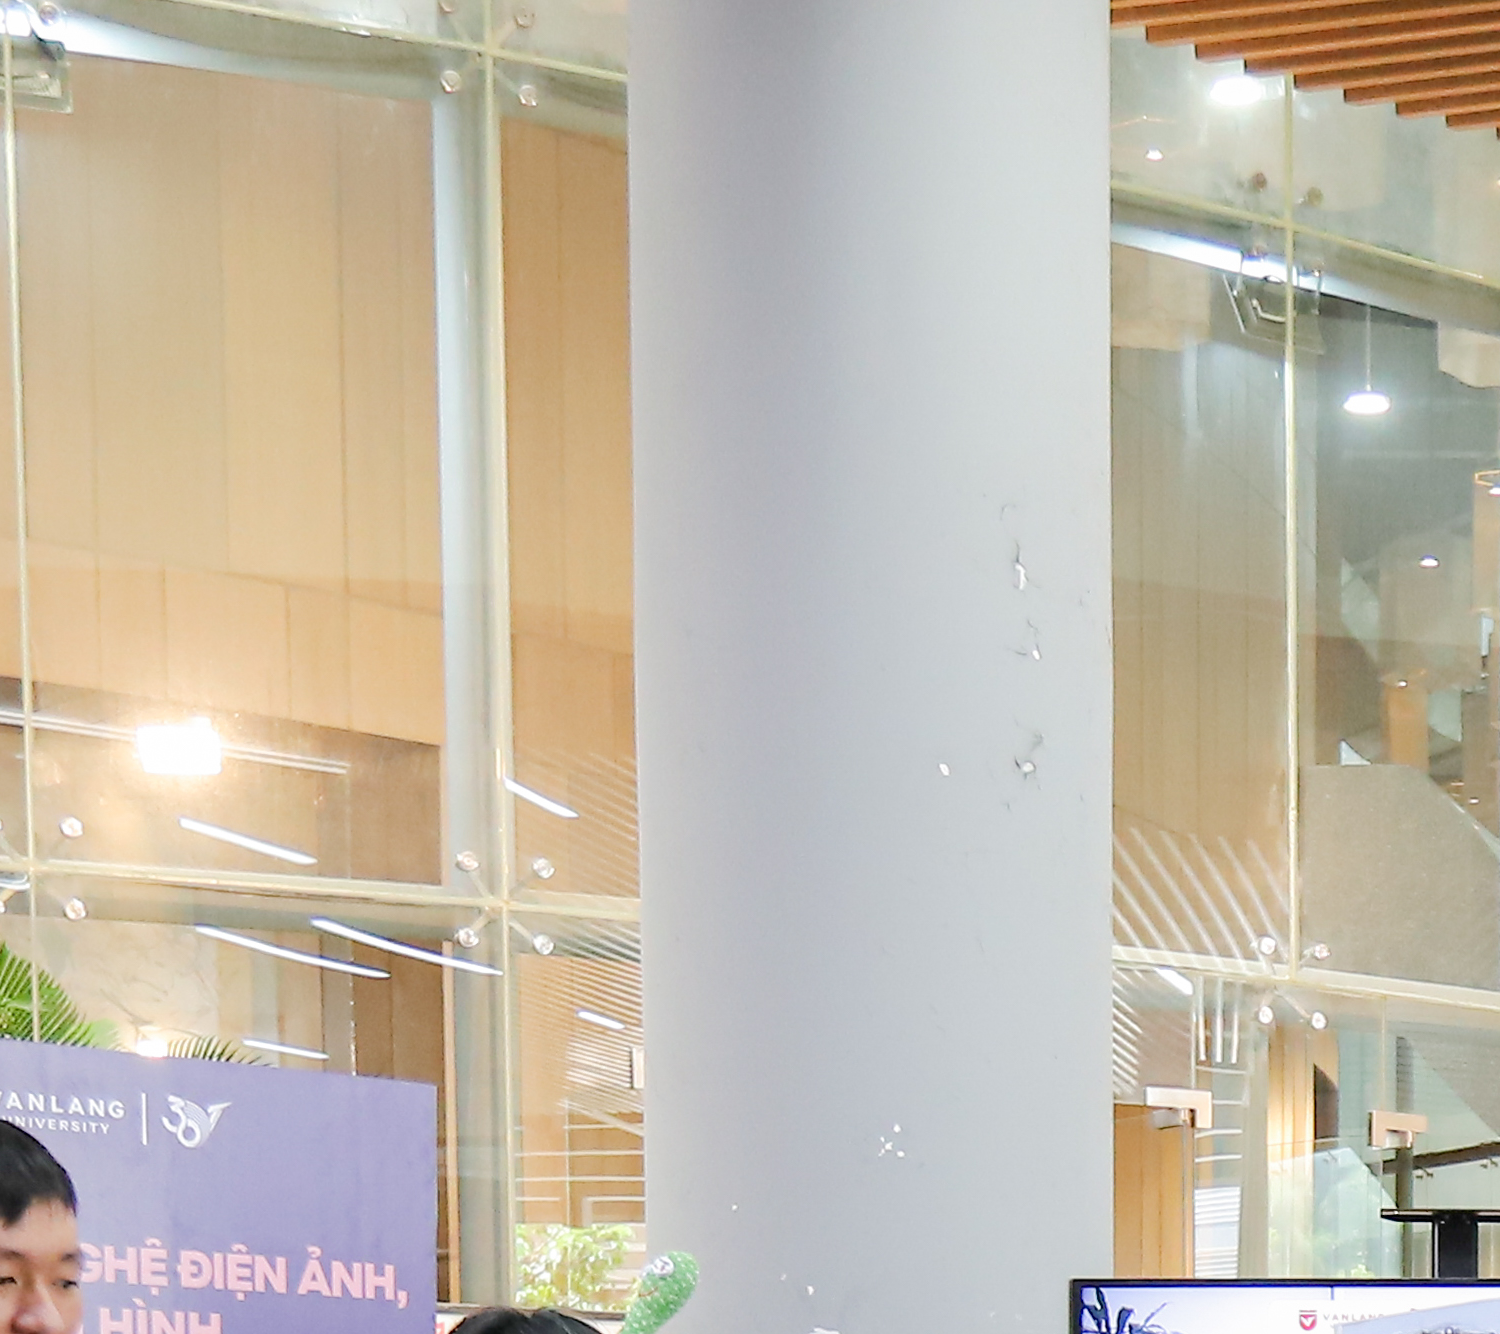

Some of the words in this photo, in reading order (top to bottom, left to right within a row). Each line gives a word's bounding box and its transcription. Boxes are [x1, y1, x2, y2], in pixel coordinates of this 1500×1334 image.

[82, 1238, 168, 1295] GHỆ
[177, 1242, 285, 1294] ĐIỆN
[297, 1244, 408, 1309] ẢNH,
